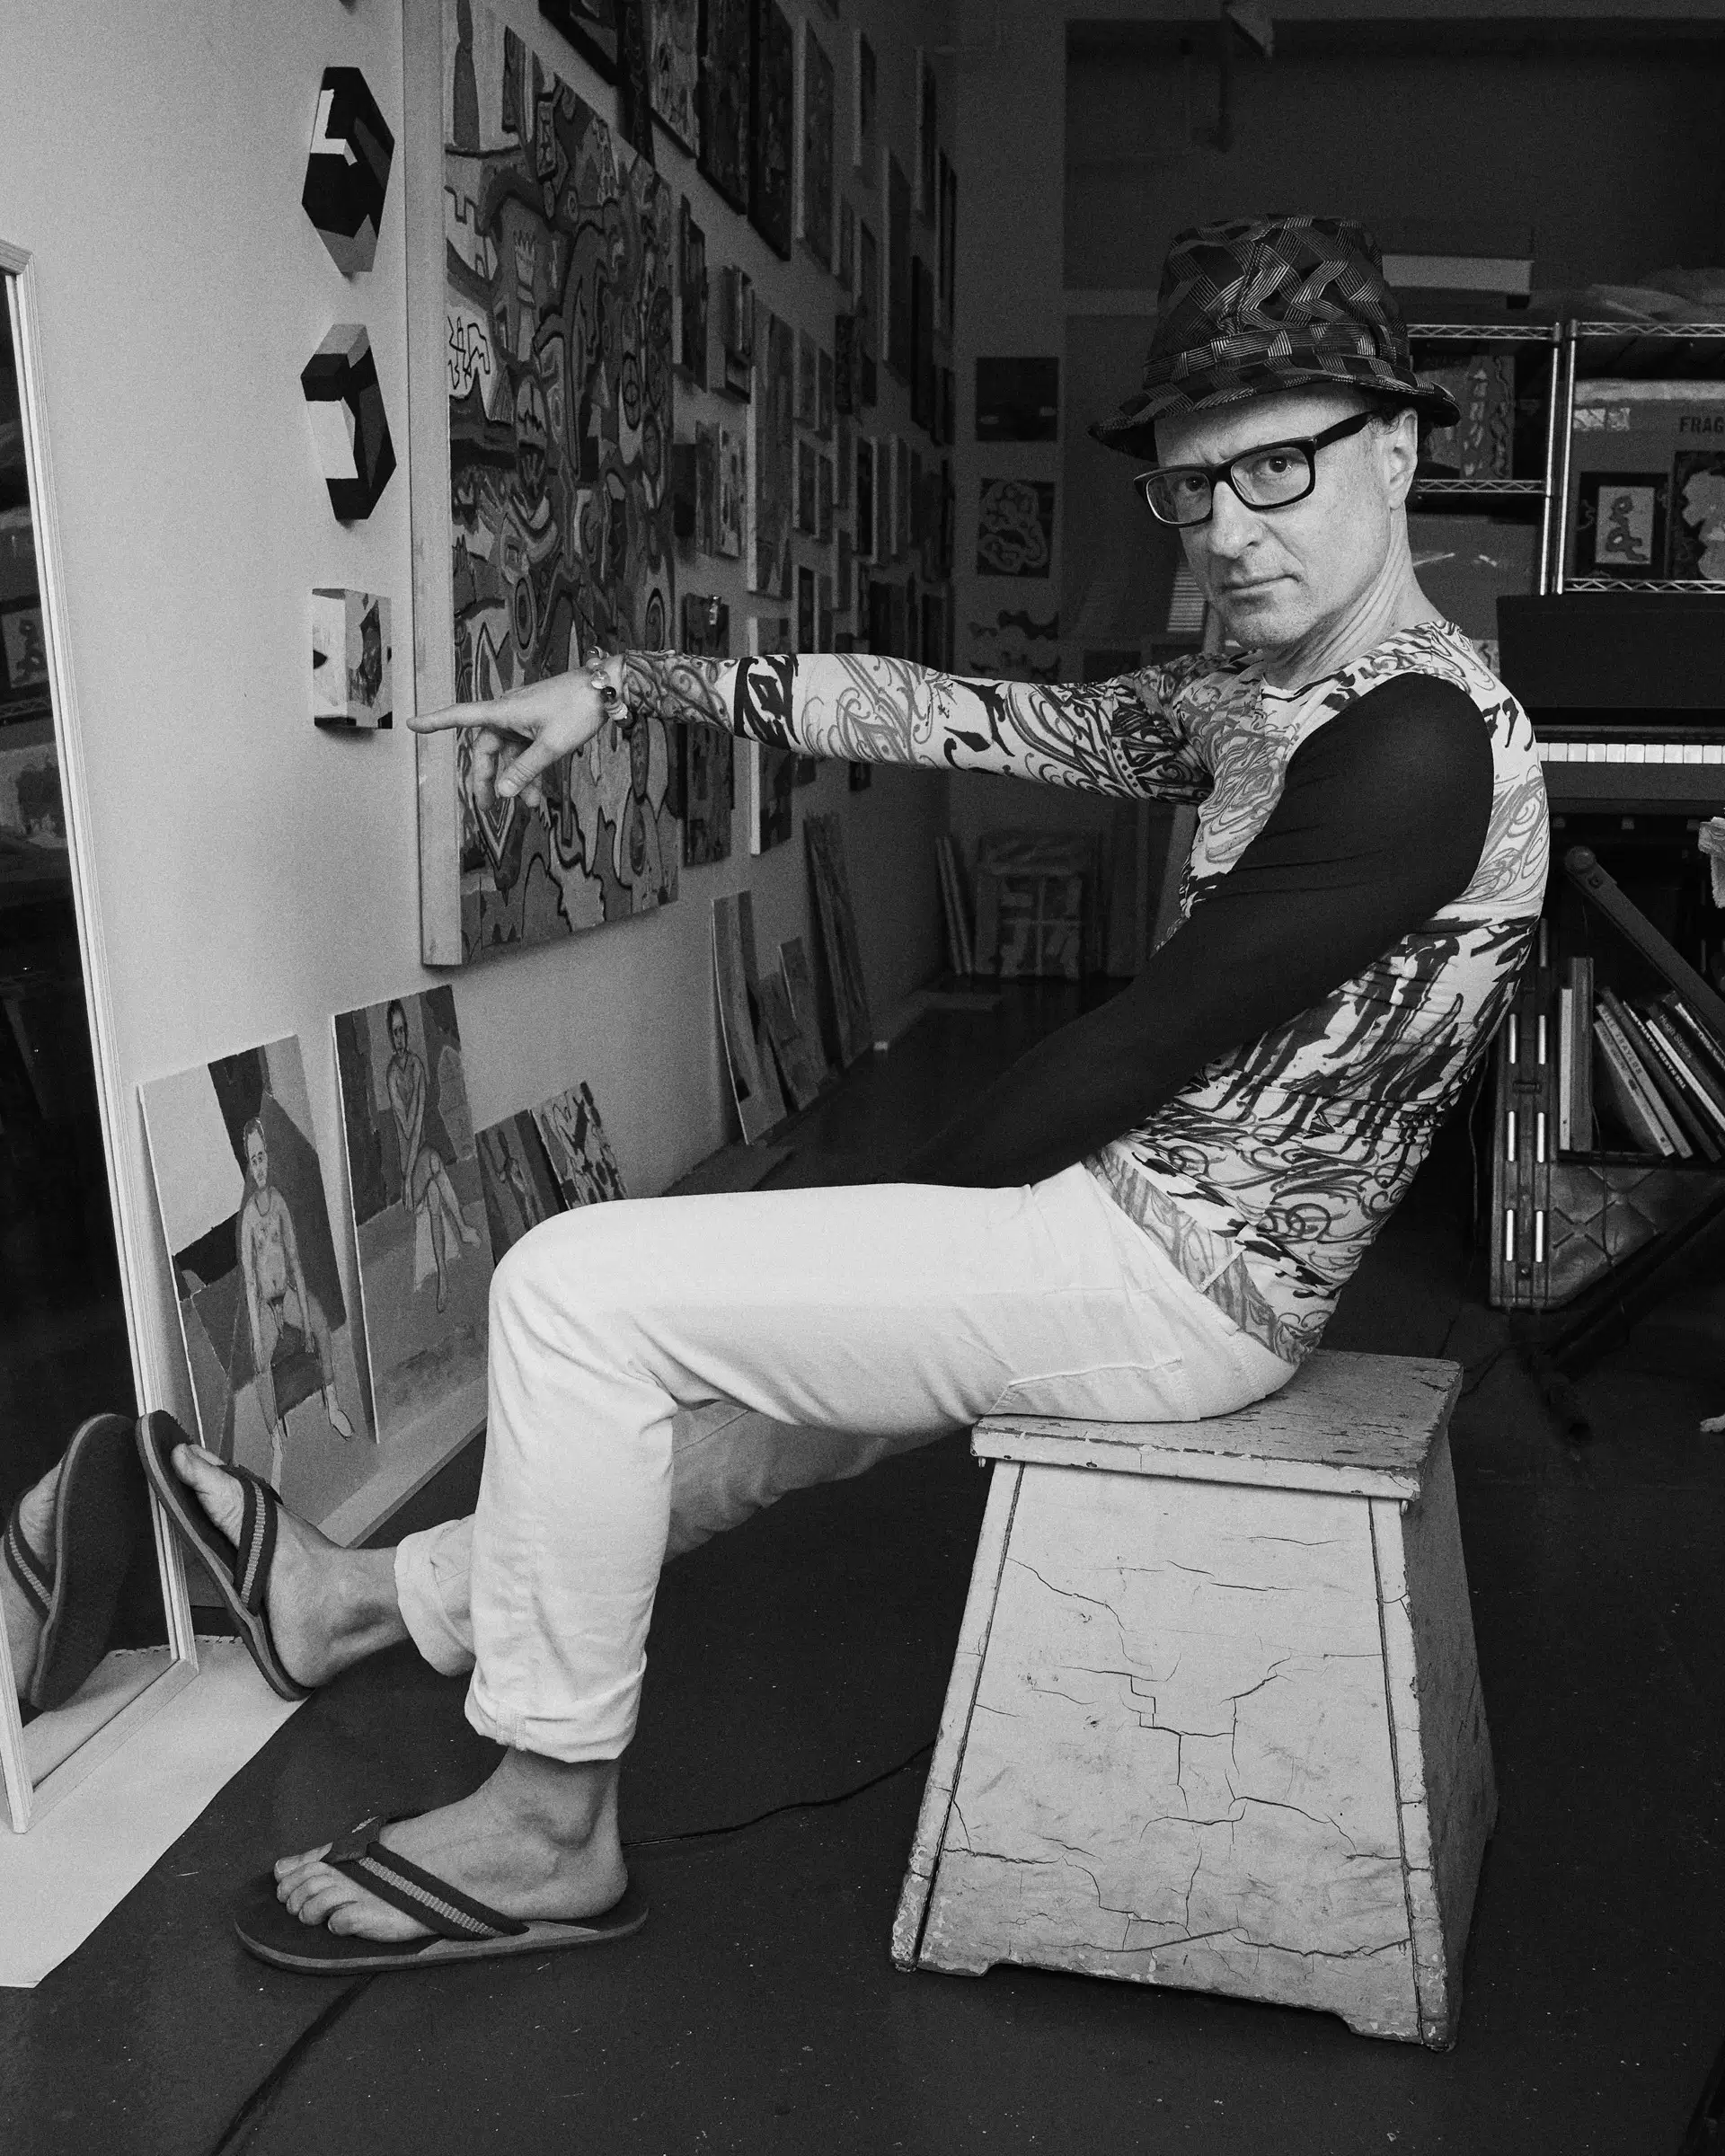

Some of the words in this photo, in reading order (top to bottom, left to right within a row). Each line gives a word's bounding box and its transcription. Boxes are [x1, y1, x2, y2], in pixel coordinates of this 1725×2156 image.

[1679, 416, 1725, 433] FRAG
[1656, 1012, 1677, 1037] Hugh
[1657, 1050, 1676, 1076] NAKED
[1673, 1074, 1686, 1090] THE
